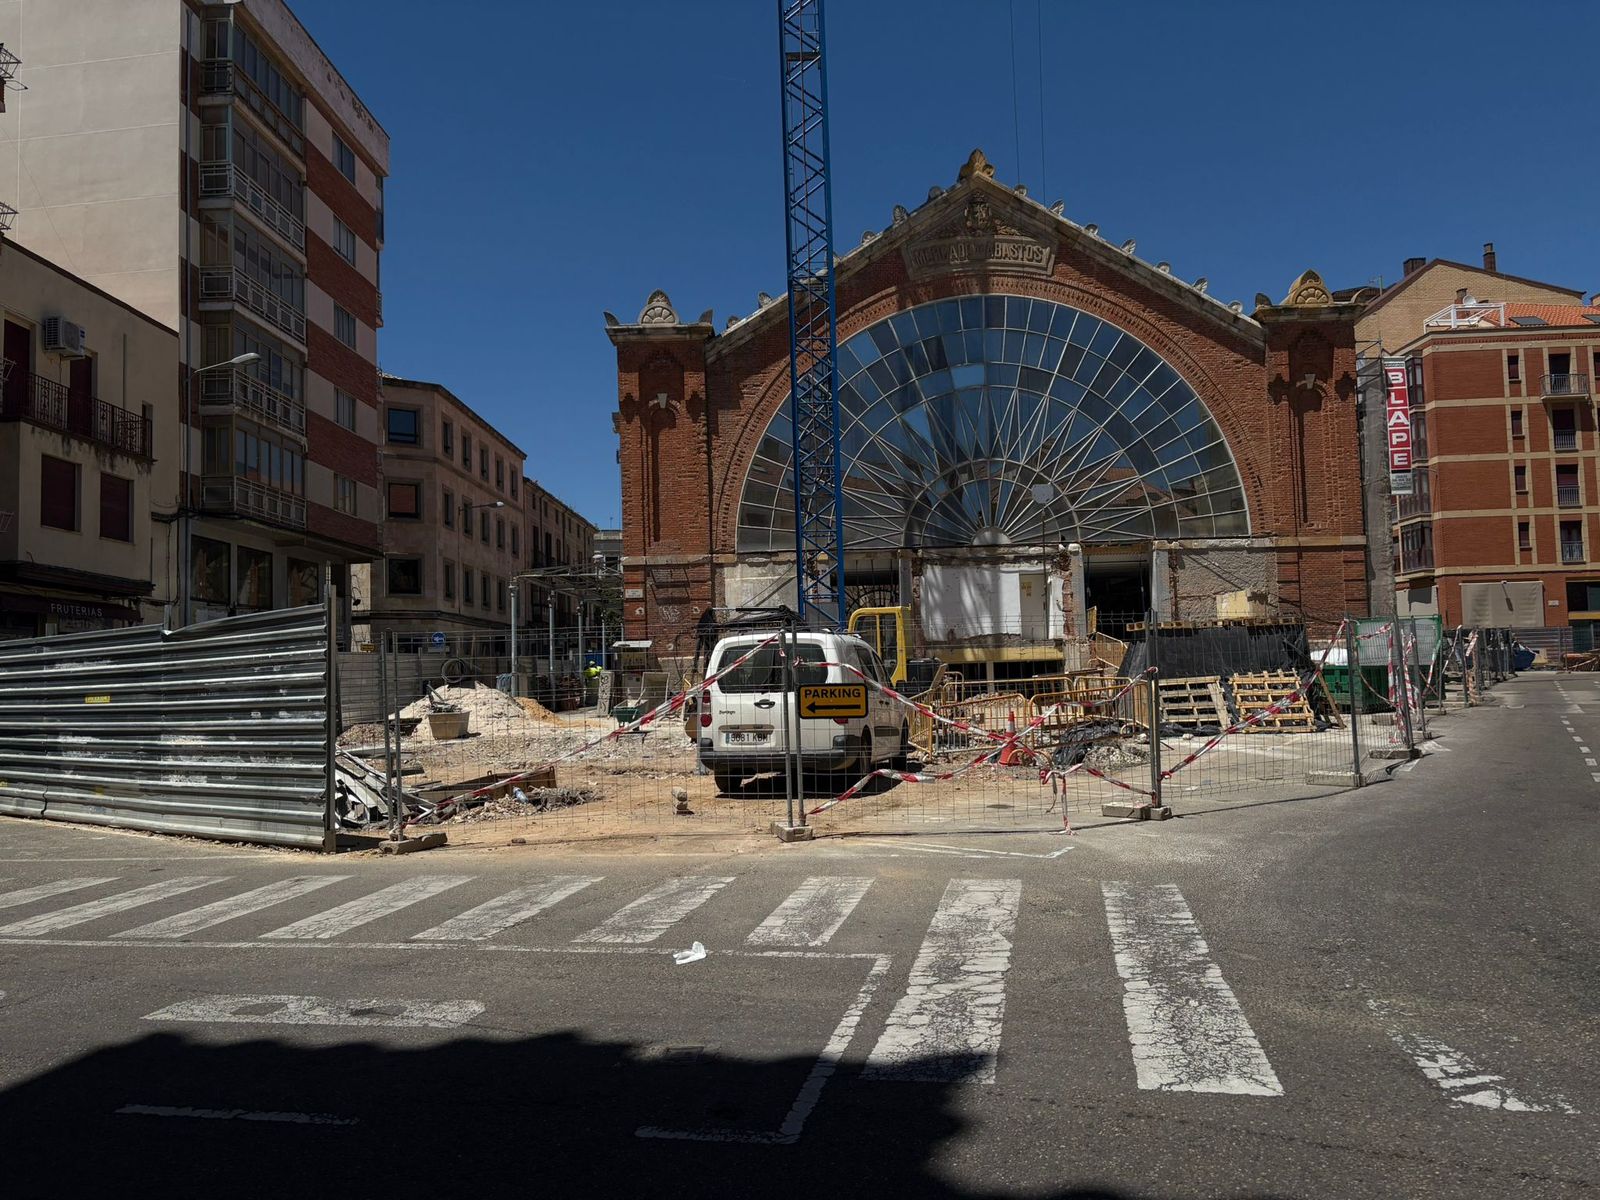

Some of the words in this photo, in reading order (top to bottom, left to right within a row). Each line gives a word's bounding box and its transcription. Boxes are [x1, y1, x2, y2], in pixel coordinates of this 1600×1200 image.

[1388, 370, 1410, 466] BLAPE
[50, 603, 103, 617] FRUTERIAS
[804, 688, 861, 699] PARKING
